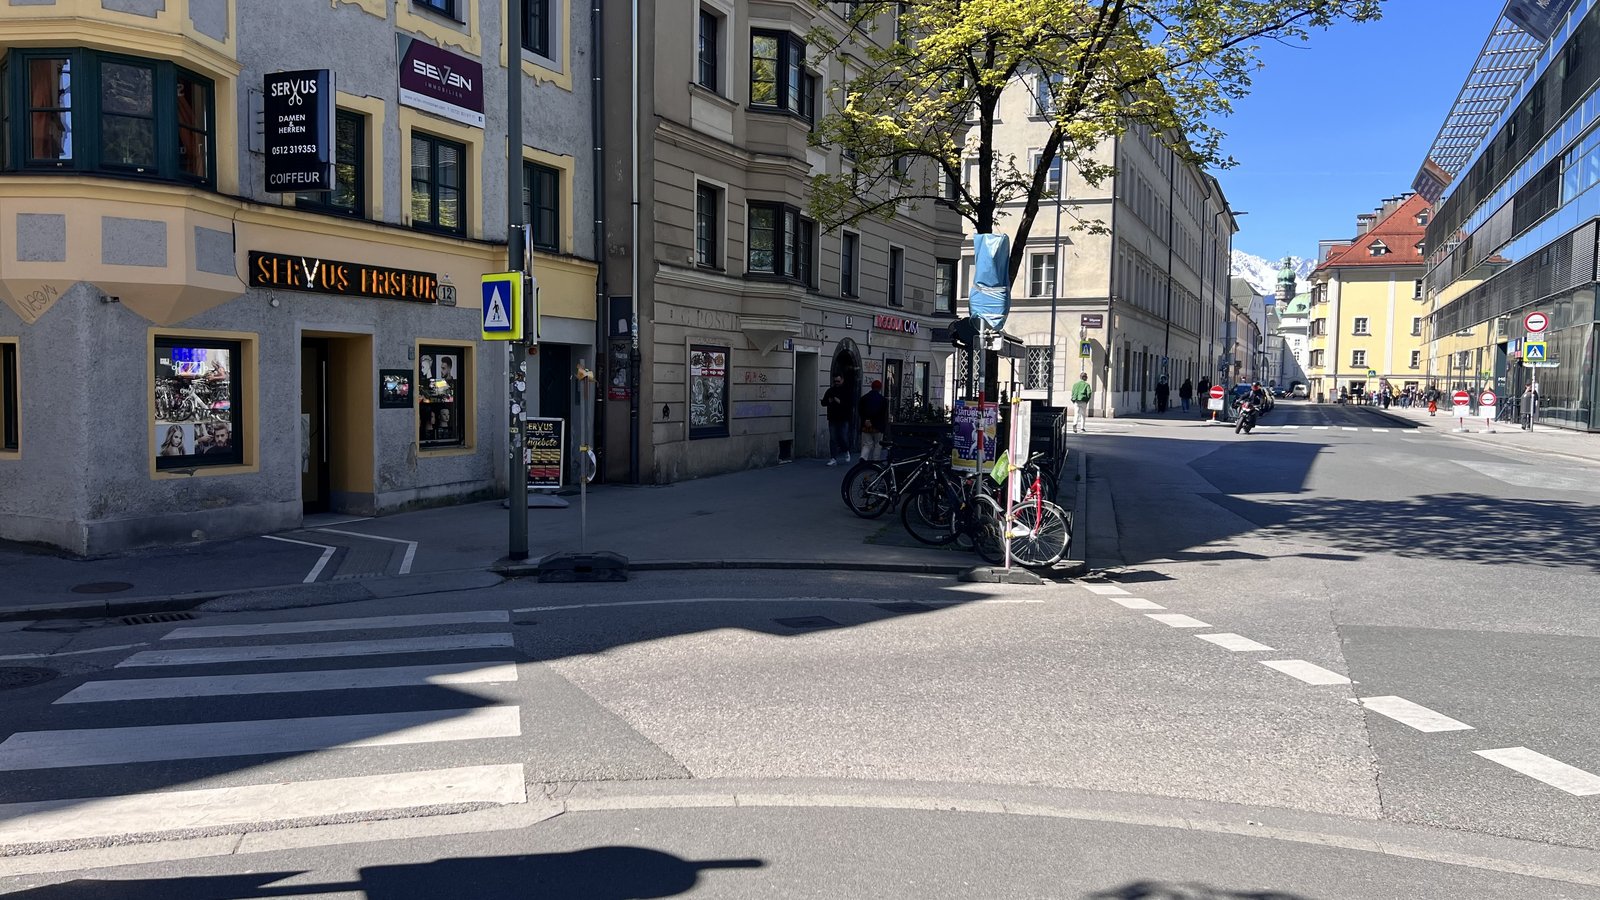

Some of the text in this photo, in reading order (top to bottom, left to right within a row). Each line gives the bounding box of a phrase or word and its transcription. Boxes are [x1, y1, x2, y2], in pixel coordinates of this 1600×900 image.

[413, 59, 472, 92] SEVEN
[271, 79, 317, 101] SERVUS
[424, 81, 463, 98] IMMOBILIEN
[278, 114, 306, 122] DAMEN
[278, 126, 306, 134] HERREN
[271, 145, 316, 155] 0512 319353
[270, 172, 320, 184] COIFFEUR
[257, 255, 350, 291] SERVUS
[443, 287, 452, 299] 12
[904, 319, 920, 334] CASA
